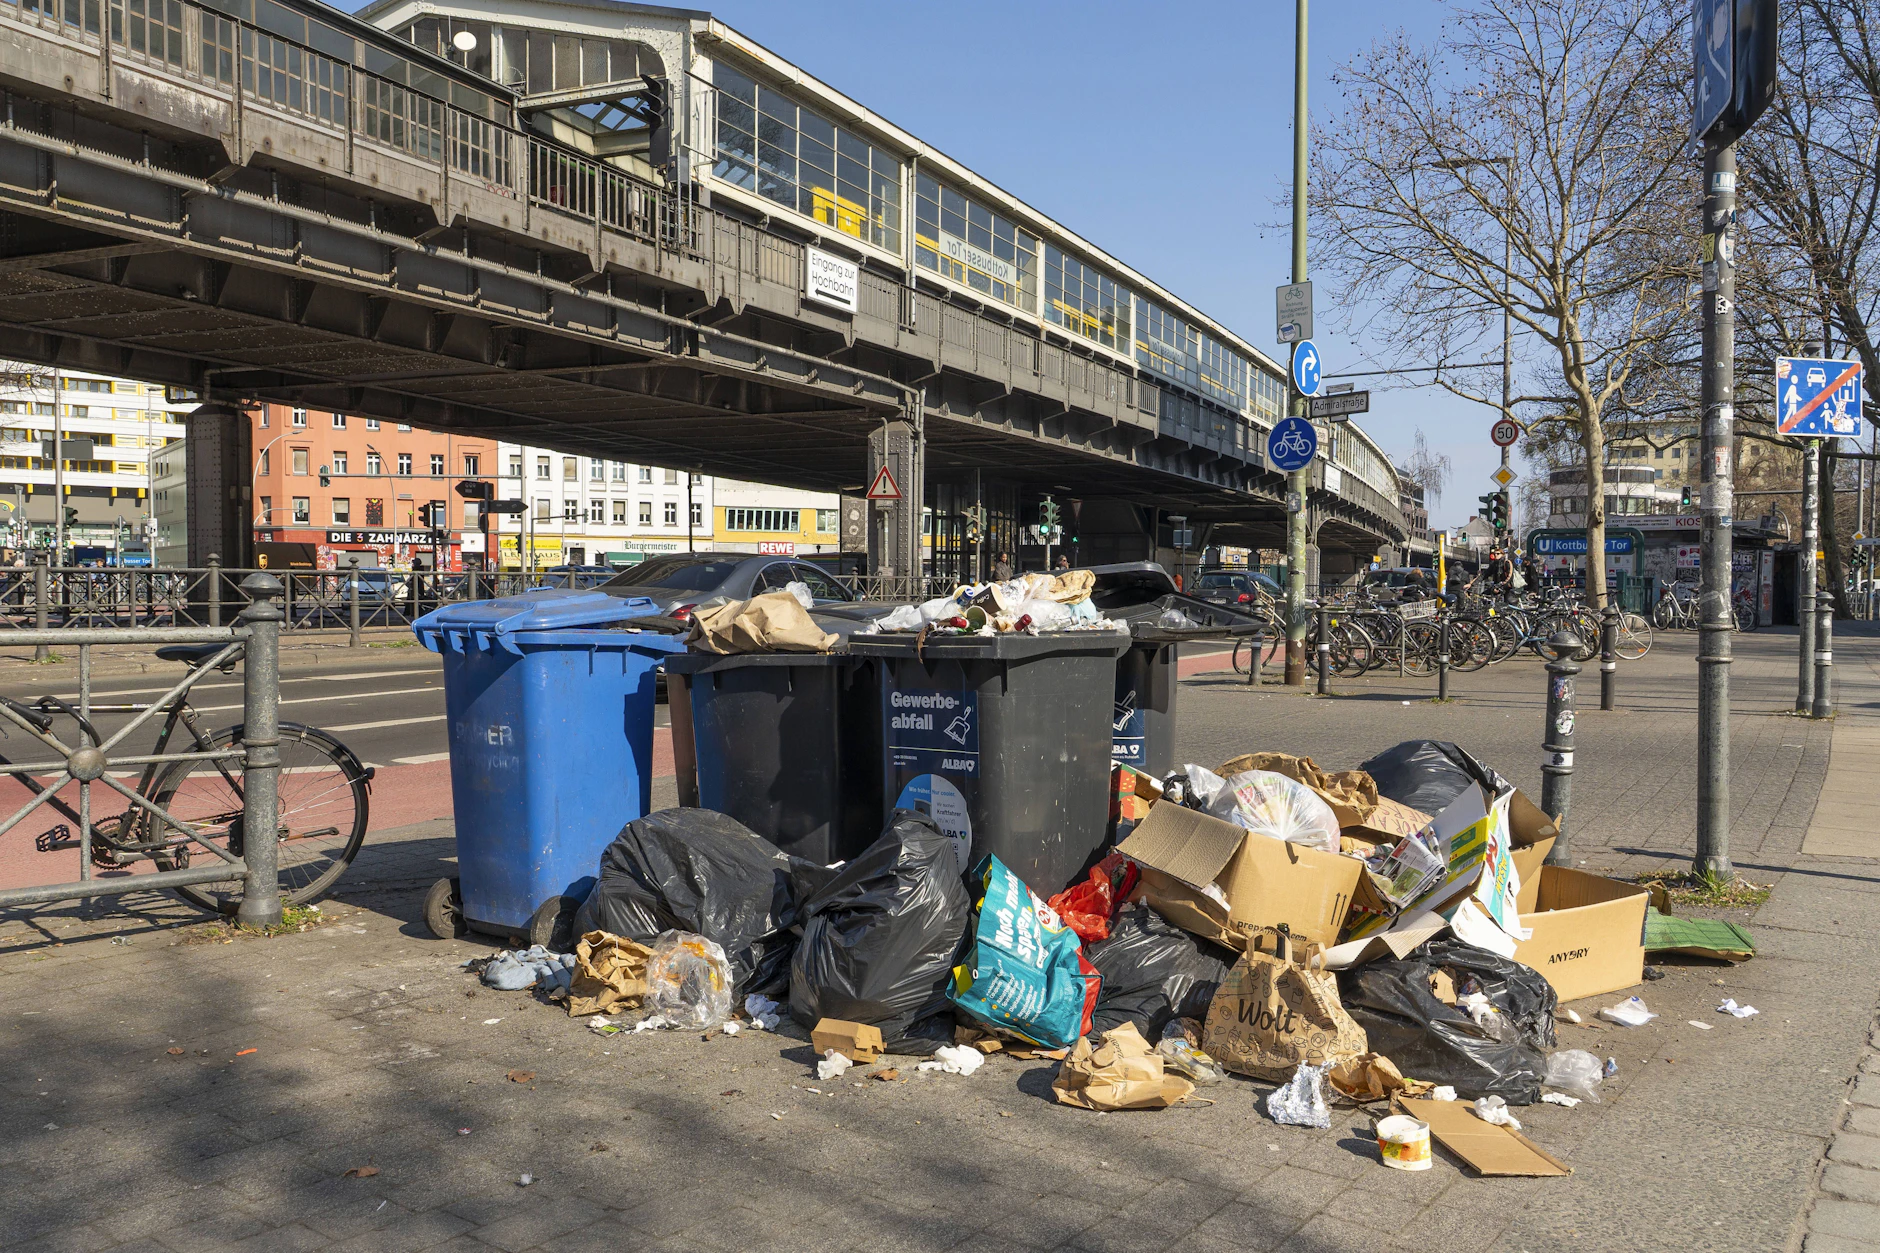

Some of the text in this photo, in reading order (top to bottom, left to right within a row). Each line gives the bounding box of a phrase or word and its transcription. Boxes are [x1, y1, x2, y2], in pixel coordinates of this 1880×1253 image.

[812, 252, 854, 280] Eingang zur
[812, 271, 854, 298] Hochbahn
[1314, 397, 1364, 411] Admiralstraße
[1497, 426, 1513, 440] 50
[331, 532, 352, 542] DIE
[356, 532, 364, 542] 3
[624, 540, 678, 551] Burgermeister
[760, 543, 794, 554] REWE
[1539, 540, 1628, 552] U Kottbur Tor
[890, 691, 960, 710] Gewerbe-
[892, 712, 933, 730] abfall
[942, 758, 966, 770] ALBA
[942, 829, 958, 838] LBA
[994, 908, 1014, 950] Noch
[1004, 869, 1018, 910] mehr
[1016, 906, 1037, 960] sparen.
[1547, 946, 1590, 965] ANYDRY
[1238, 998, 1298, 1034] Wolt
